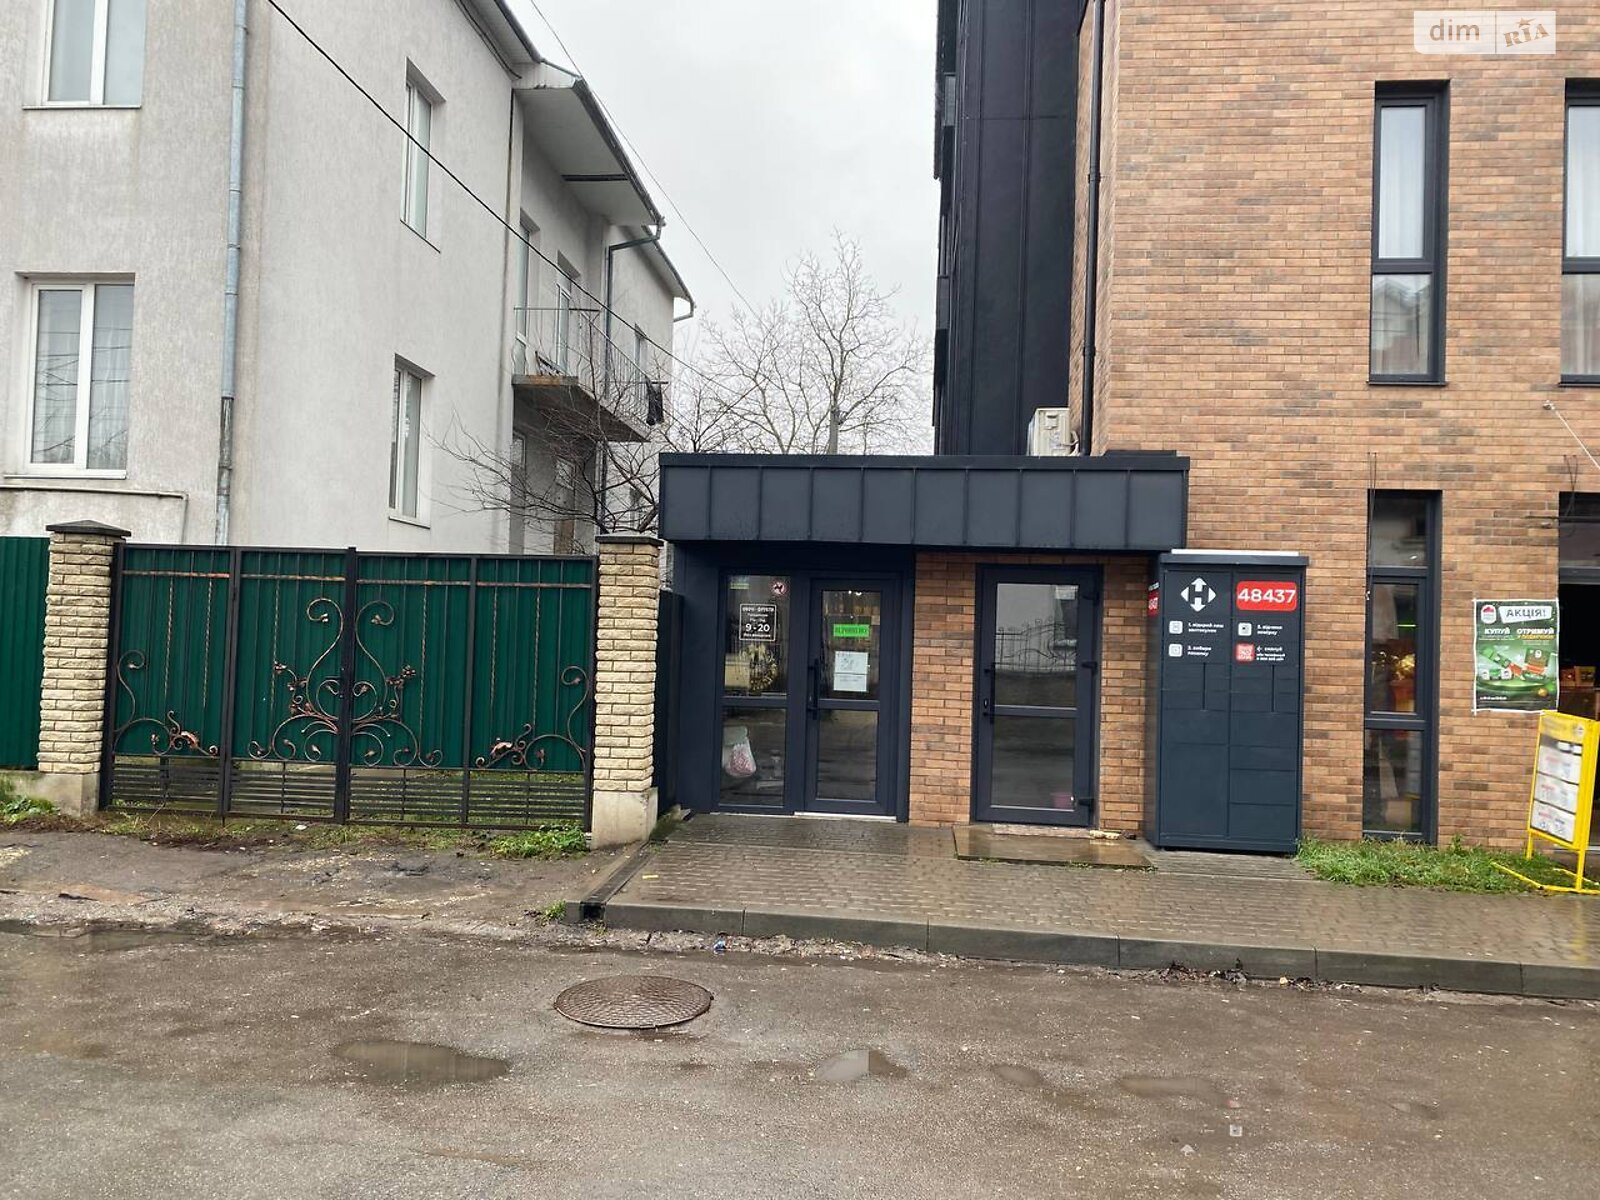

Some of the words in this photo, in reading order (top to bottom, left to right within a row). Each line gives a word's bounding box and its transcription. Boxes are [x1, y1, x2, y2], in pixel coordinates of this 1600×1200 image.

[1238, 588, 1296, 604] 48437
[1506, 608, 1546, 619] АКЦІЯ!
[1484, 627, 1510, 635] КУПУЙ
